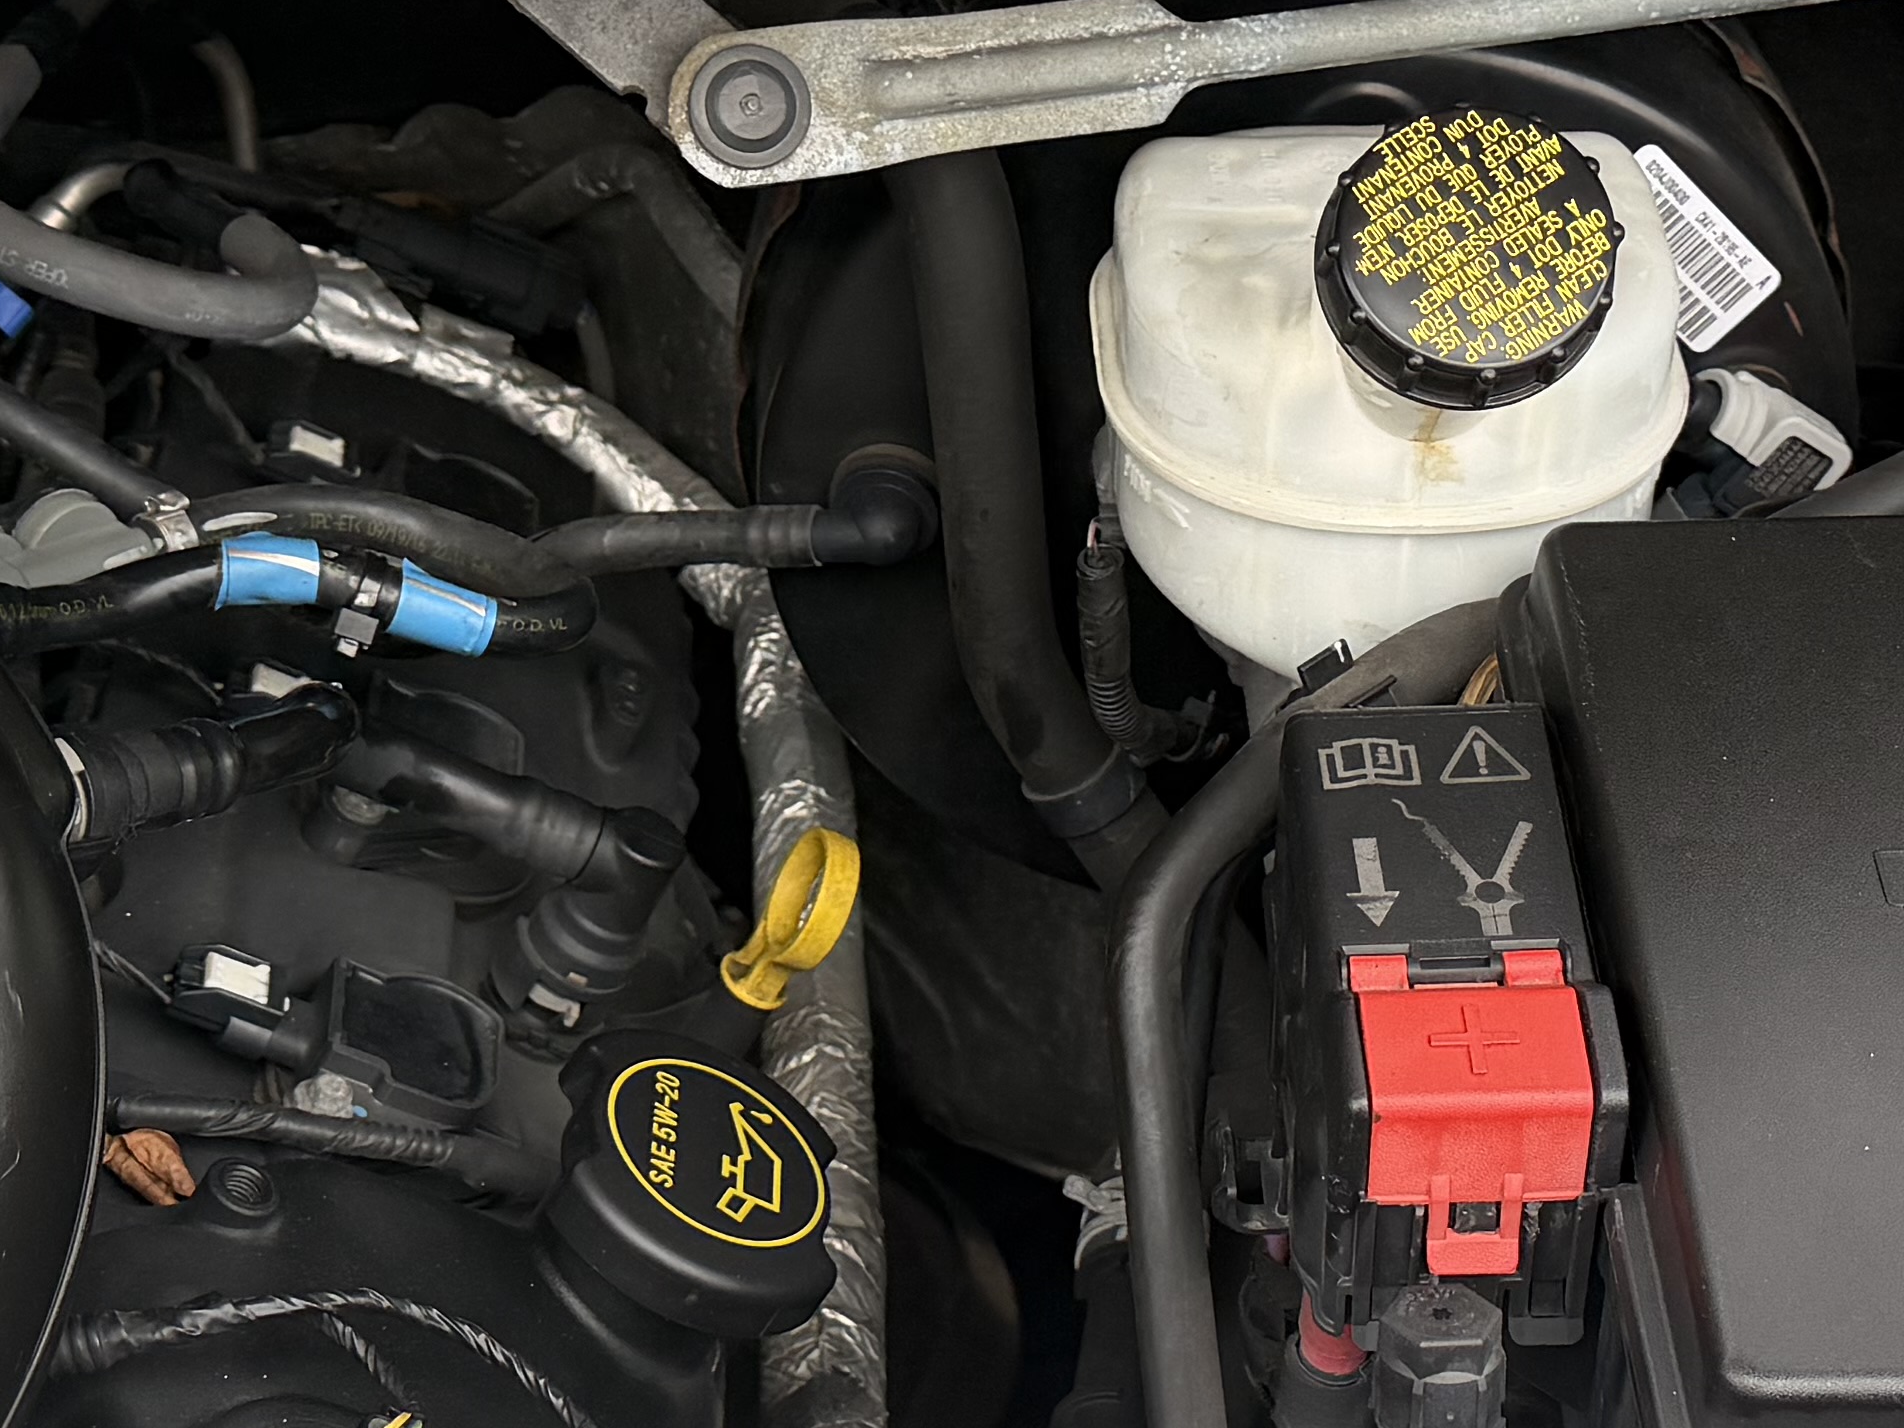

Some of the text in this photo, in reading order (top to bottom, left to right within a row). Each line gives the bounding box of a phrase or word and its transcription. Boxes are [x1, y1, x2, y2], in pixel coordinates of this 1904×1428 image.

[1352, 136, 1442, 203] CONTENANT
[1353, 125, 1541, 256] PLOYER QUE DU LIQUIDE
[1363, 118, 1510, 221] DOT 4 PROVENANT
[1464, 180, 1490, 204] LE
[1489, 164, 1515, 189] DE
[1515, 135, 1562, 173] AVANT
[1379, 159, 1565, 288] NETTOYER LE BOUCHON
[1412, 199, 1581, 317] A SEALED CONTAINER.
[1417, 197, 1541, 290] AVERTISSEMENT:
[1409, 209, 1606, 346] ONLY DOT 4 FLUID FROM
[1428, 230, 1611, 358] BEFORE REMOVING. USE
[1465, 254, 1609, 365] CLEAN FILLER CAP
[1756, 274, 1772, 290] A
[1502, 298, 1590, 363] WARNING:
[648, 1070, 680, 1188] SAE 5W-20
